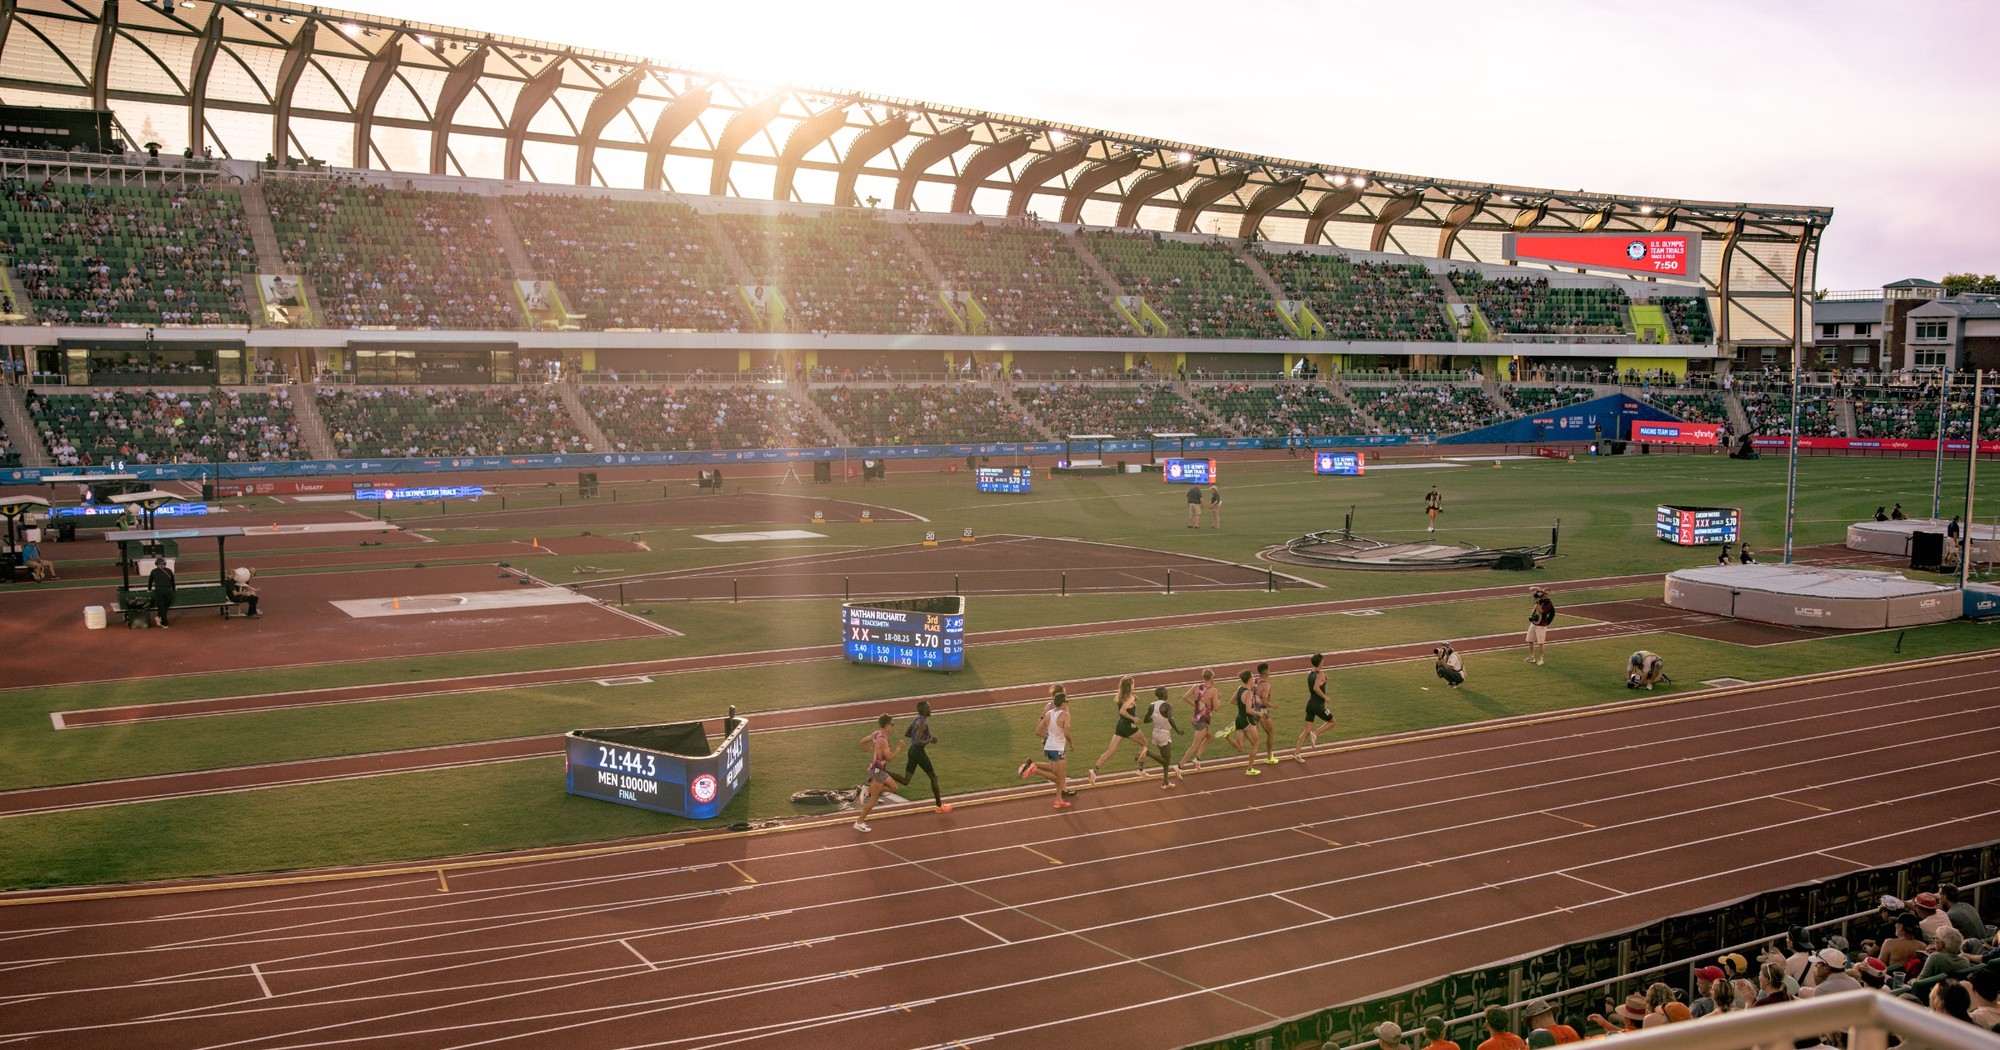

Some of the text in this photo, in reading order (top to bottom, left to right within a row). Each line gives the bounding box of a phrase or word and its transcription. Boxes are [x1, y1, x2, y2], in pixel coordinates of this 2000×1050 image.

[1654, 261, 1678, 269] 7:50
[1694, 430, 1714, 439] xfinity
[1726, 518, 1737, 526] 5.70
[926, 532, 935, 540] 20
[1725, 534, 1736, 542] 5.70
[851, 609, 906, 622] NATHAN RICHARTZ
[927, 615, 938, 624] 3rd
[924, 624, 940, 632] PLACE
[884, 633, 909, 642] 18-08.25
[915, 633, 938, 648] 5.70
[599, 747, 655, 776] 21:44.3
[598, 771, 657, 794] MEN 10000M
[619, 790, 637, 800] FINAL
